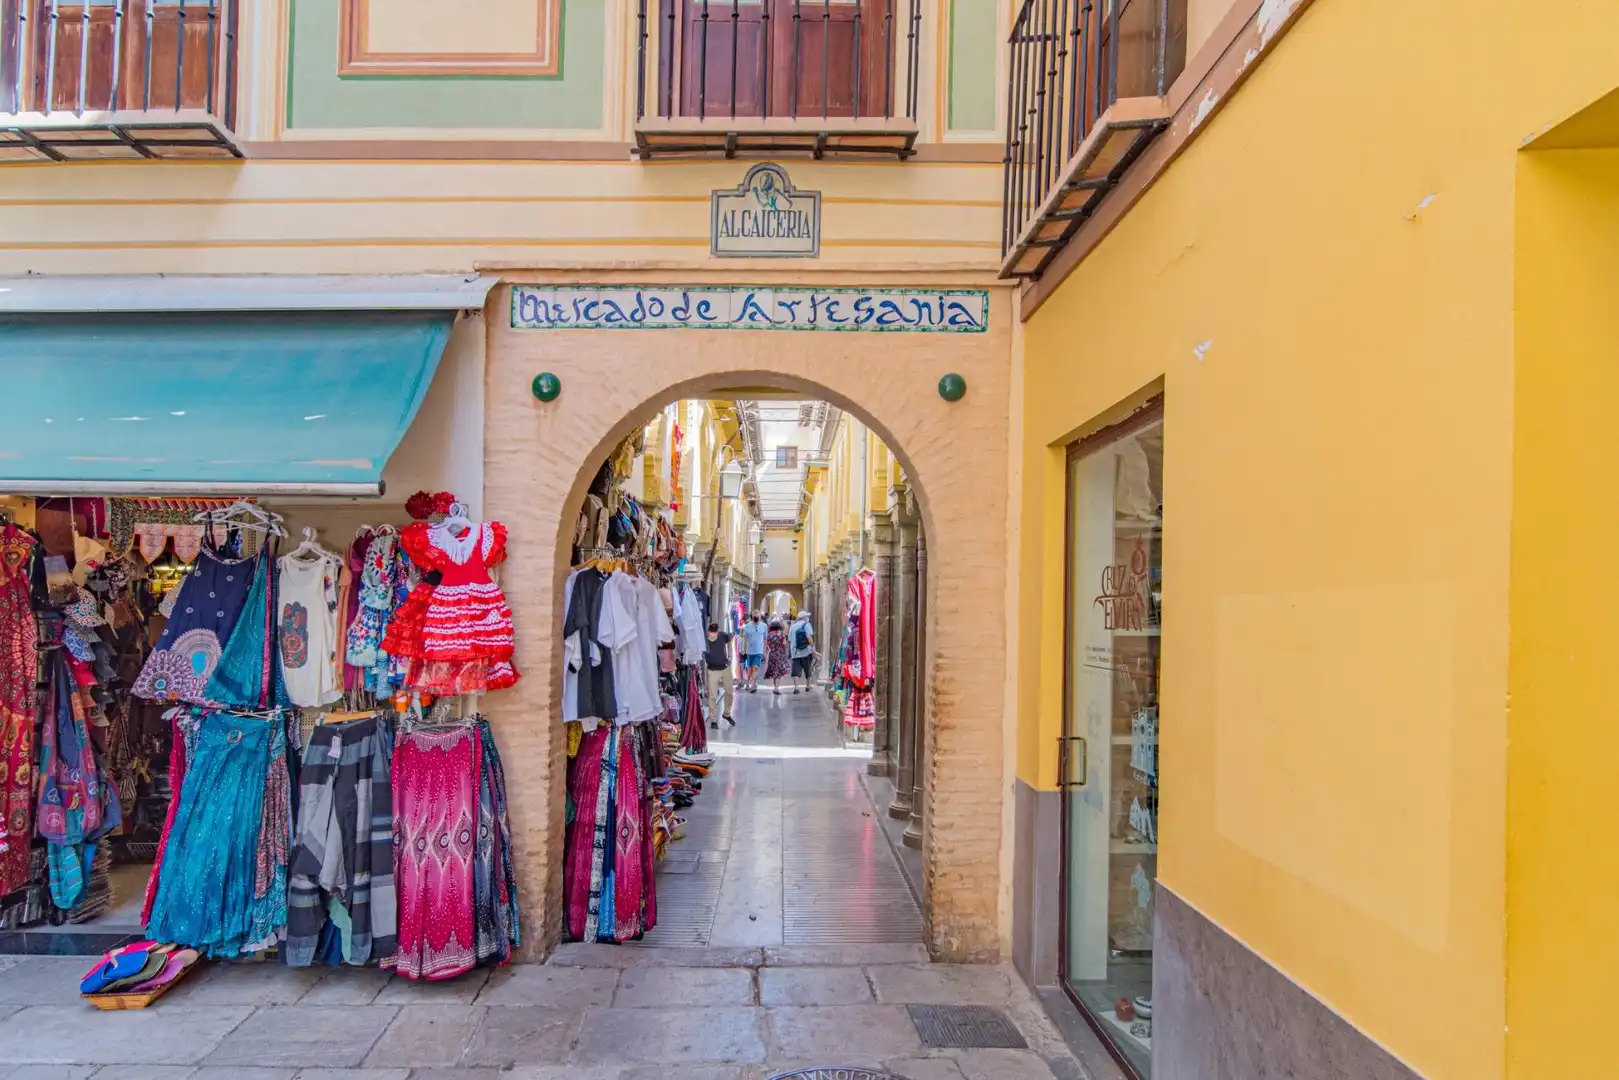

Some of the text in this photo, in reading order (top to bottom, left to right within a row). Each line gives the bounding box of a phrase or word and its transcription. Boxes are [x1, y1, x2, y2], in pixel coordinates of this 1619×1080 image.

[719, 209, 811, 239] ALCAICERIA
[519, 291, 981, 326] Mercado de Artesania
